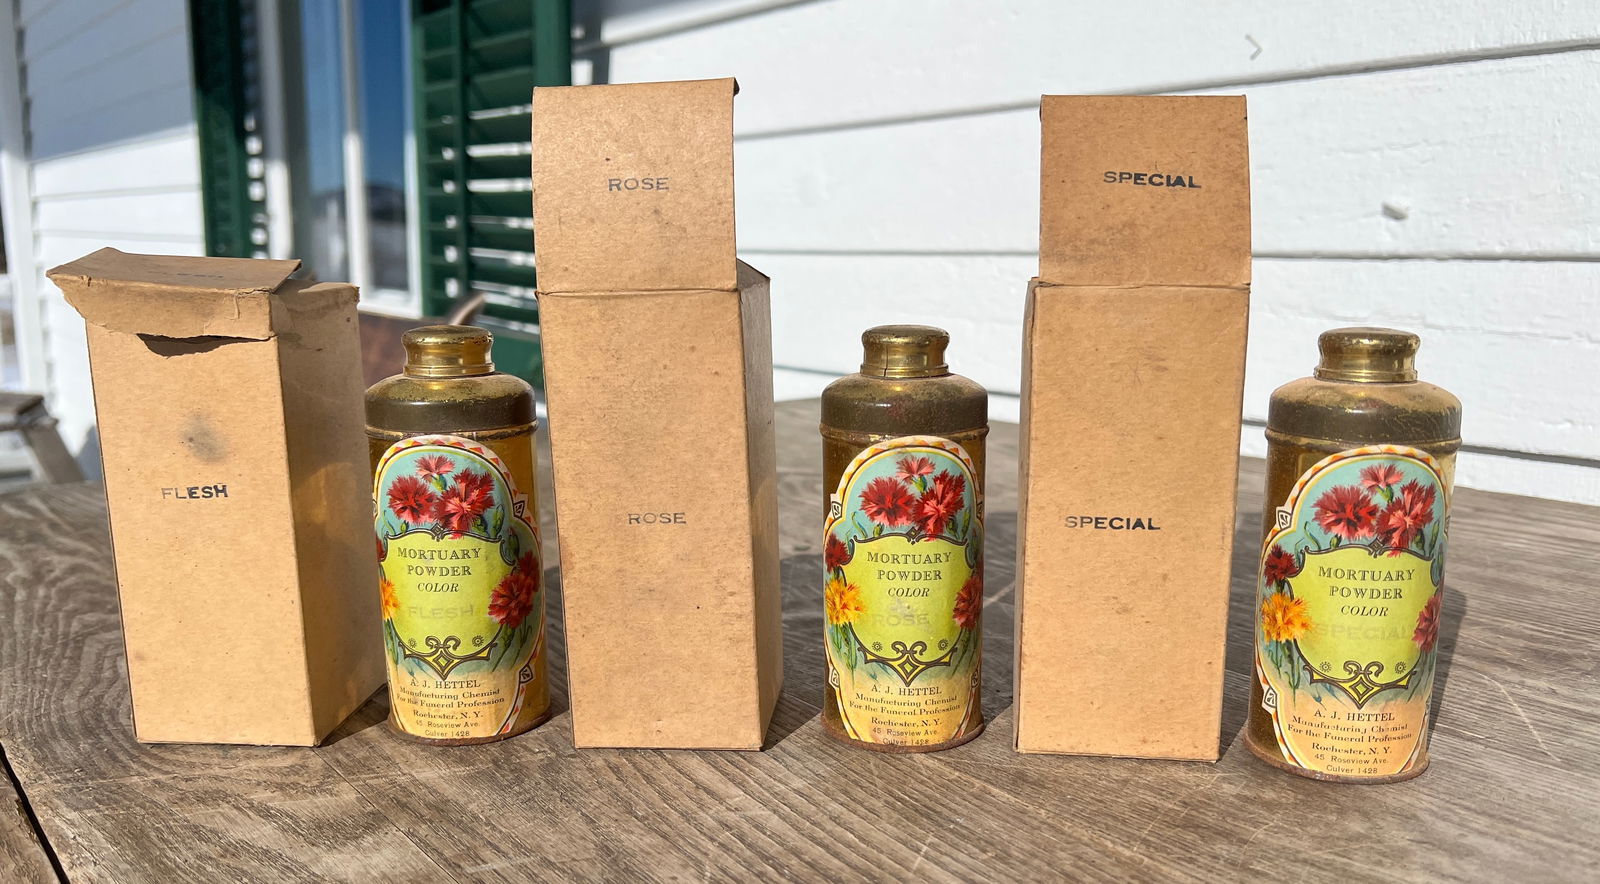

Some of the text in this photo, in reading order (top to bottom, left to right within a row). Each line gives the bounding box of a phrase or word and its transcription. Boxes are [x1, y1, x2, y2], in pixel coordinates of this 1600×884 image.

[608, 177, 670, 192] ROSE
[1103, 170, 1202, 189] SPECIAL
[161, 484, 229, 500] FLESH
[627, 512, 687, 525] ROSE
[1064, 515, 1161, 531] SPECIAL
[397, 547, 482, 561] MORTUARY
[867, 551, 952, 565] MORTUARY
[407, 564, 472, 577] POWDER
[877, 569, 942, 582] POWDER
[1318, 565, 1416, 582] MORTUARY
[417, 582, 460, 593] COLOR
[887, 587, 930, 598] COLOR
[1329, 585, 1403, 600] POWDER
[408, 604, 474, 619] FLESH
[1341, 605, 1389, 617] COLOR
[410, 679, 481, 689] A. J. HETTEL
[871, 684, 942, 697] A. J. HETTEL
[400, 687, 500, 700] Manufacturing Chemist
[855, 692, 958, 708] Manufacturing Chemist
[397, 694, 505, 708] For the Funeral Profession
[849, 700, 961, 716] For the Funeral Profession
[1314, 708, 1396, 722] A. J. HETTEL
[428, 721, 462, 729] Roseview
[921, 719, 932, 727] N.
[933, 718, 942, 726] Y.
[1292, 715, 1408, 734] Manufacturing Chemist
[886, 728, 922, 736] Roseview
[1288, 723, 1412, 743] For the Funeral Profession
[1369, 747, 1379, 755] N.
[1383, 746, 1392, 754] Y.
[1331, 755, 1370, 764] Roseview
[1326, 765, 1354, 773] Culver
